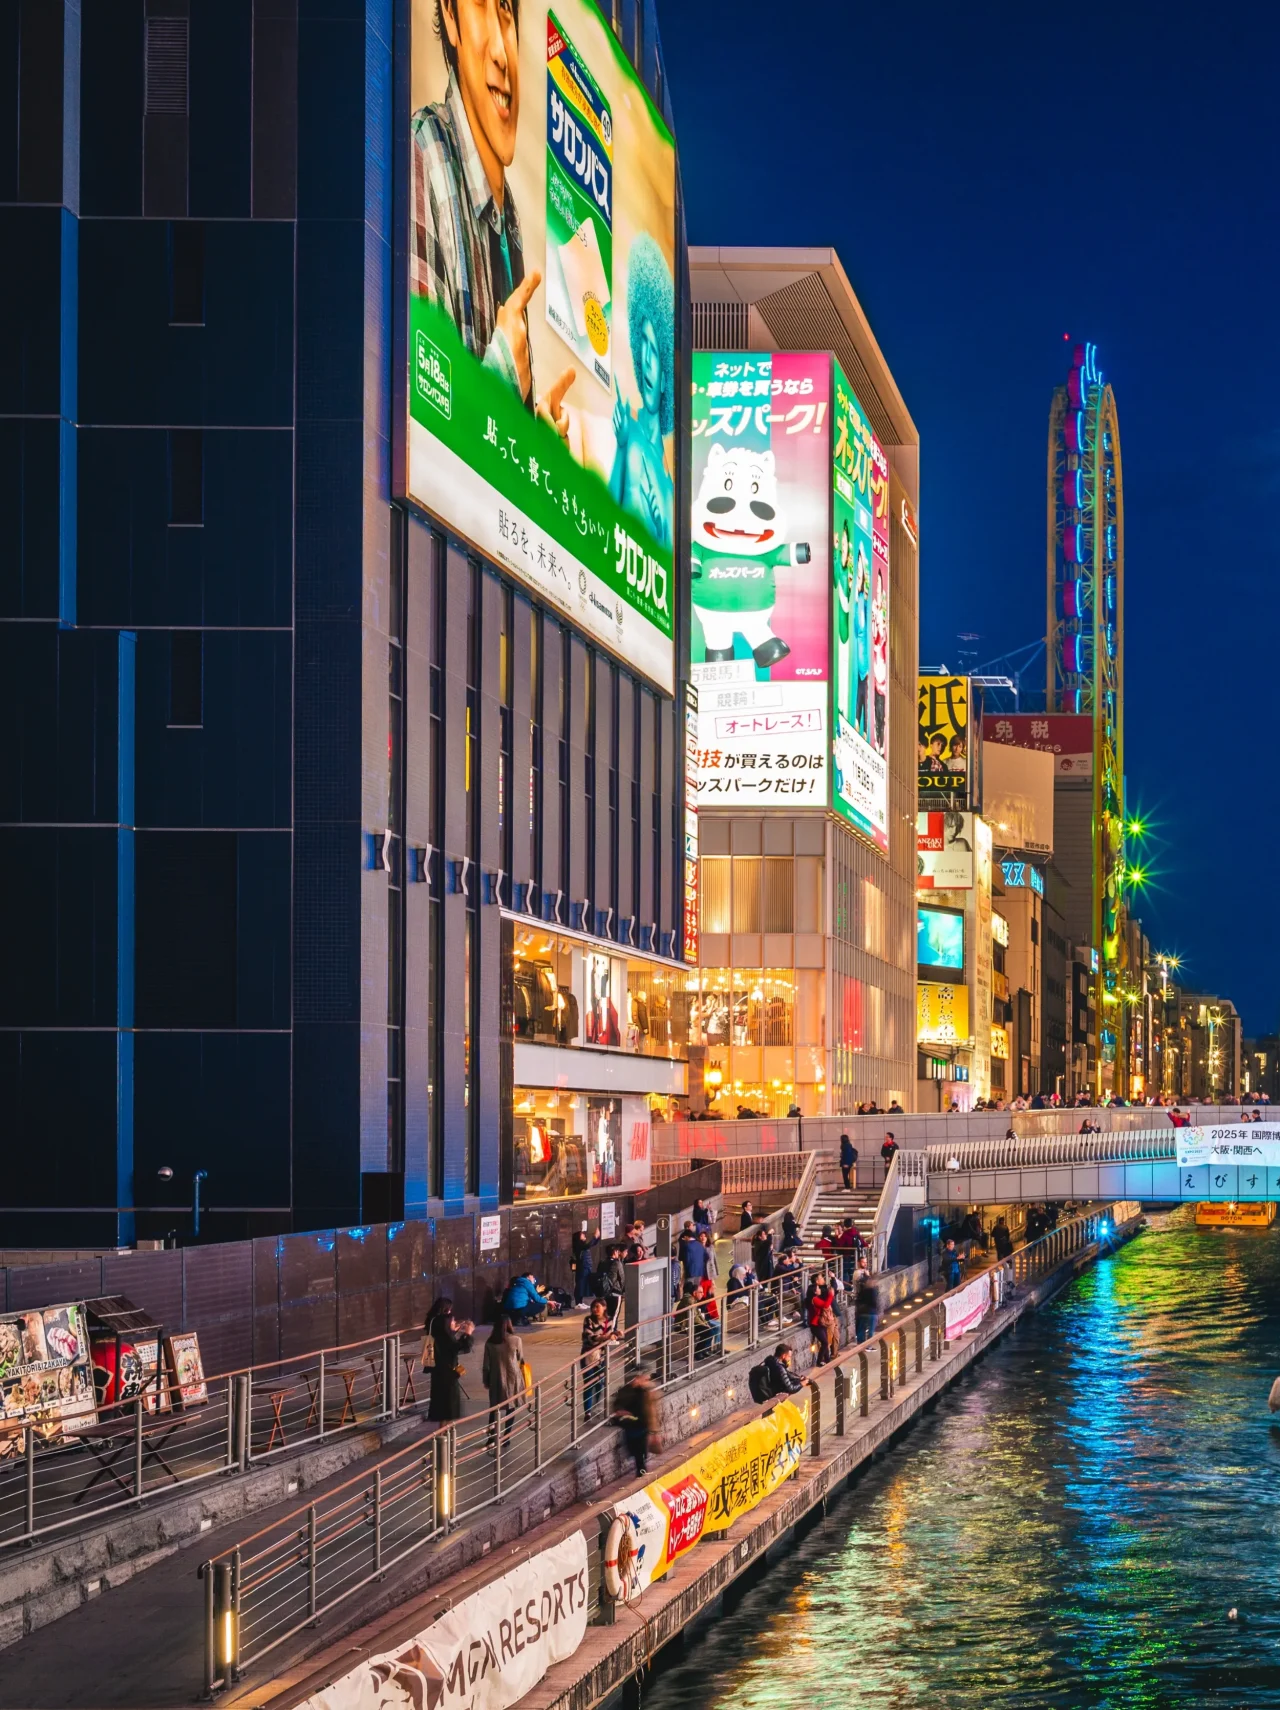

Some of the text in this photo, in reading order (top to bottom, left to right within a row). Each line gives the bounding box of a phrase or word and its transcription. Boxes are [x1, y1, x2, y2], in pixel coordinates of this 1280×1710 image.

[550, 89, 611, 219] サロンパス
[714, 361, 772, 378] ネットで
[614, 522, 669, 618] サロンパス
[708, 566, 765, 579] オッズパーク!
[725, 713, 813, 734] オートレース!
[1211, 1129, 1248, 1139] 2025年
[1211, 1145, 1262, 1156] 大阪・関西へ
[499, 1568, 586, 1666] RESORTS
